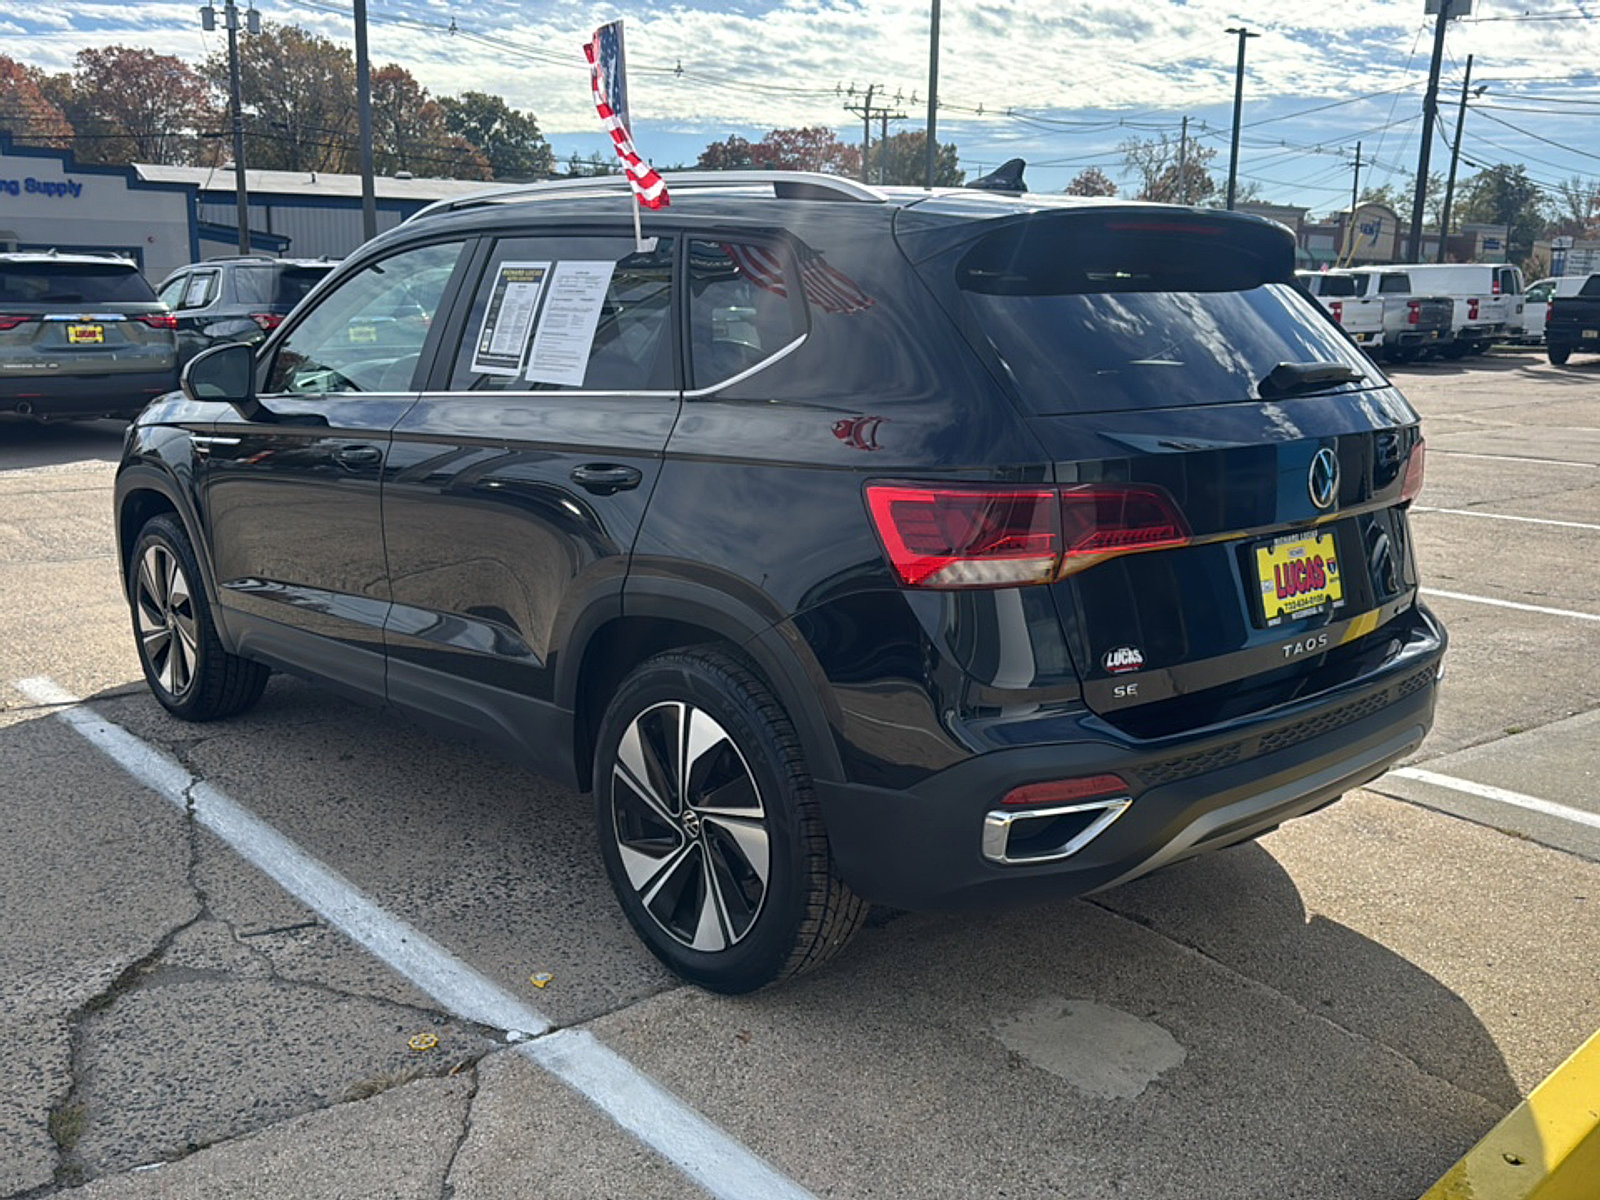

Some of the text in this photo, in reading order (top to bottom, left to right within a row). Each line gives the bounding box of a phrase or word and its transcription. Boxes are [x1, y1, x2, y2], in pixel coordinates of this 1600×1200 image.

[24, 177, 82, 197] Supply
[1274, 554, 1326, 599] LUCAS
[1282, 633, 1328, 659] TAOS
[1106, 648, 1143, 668] LUCAS
[1113, 683, 1139, 698] SE
